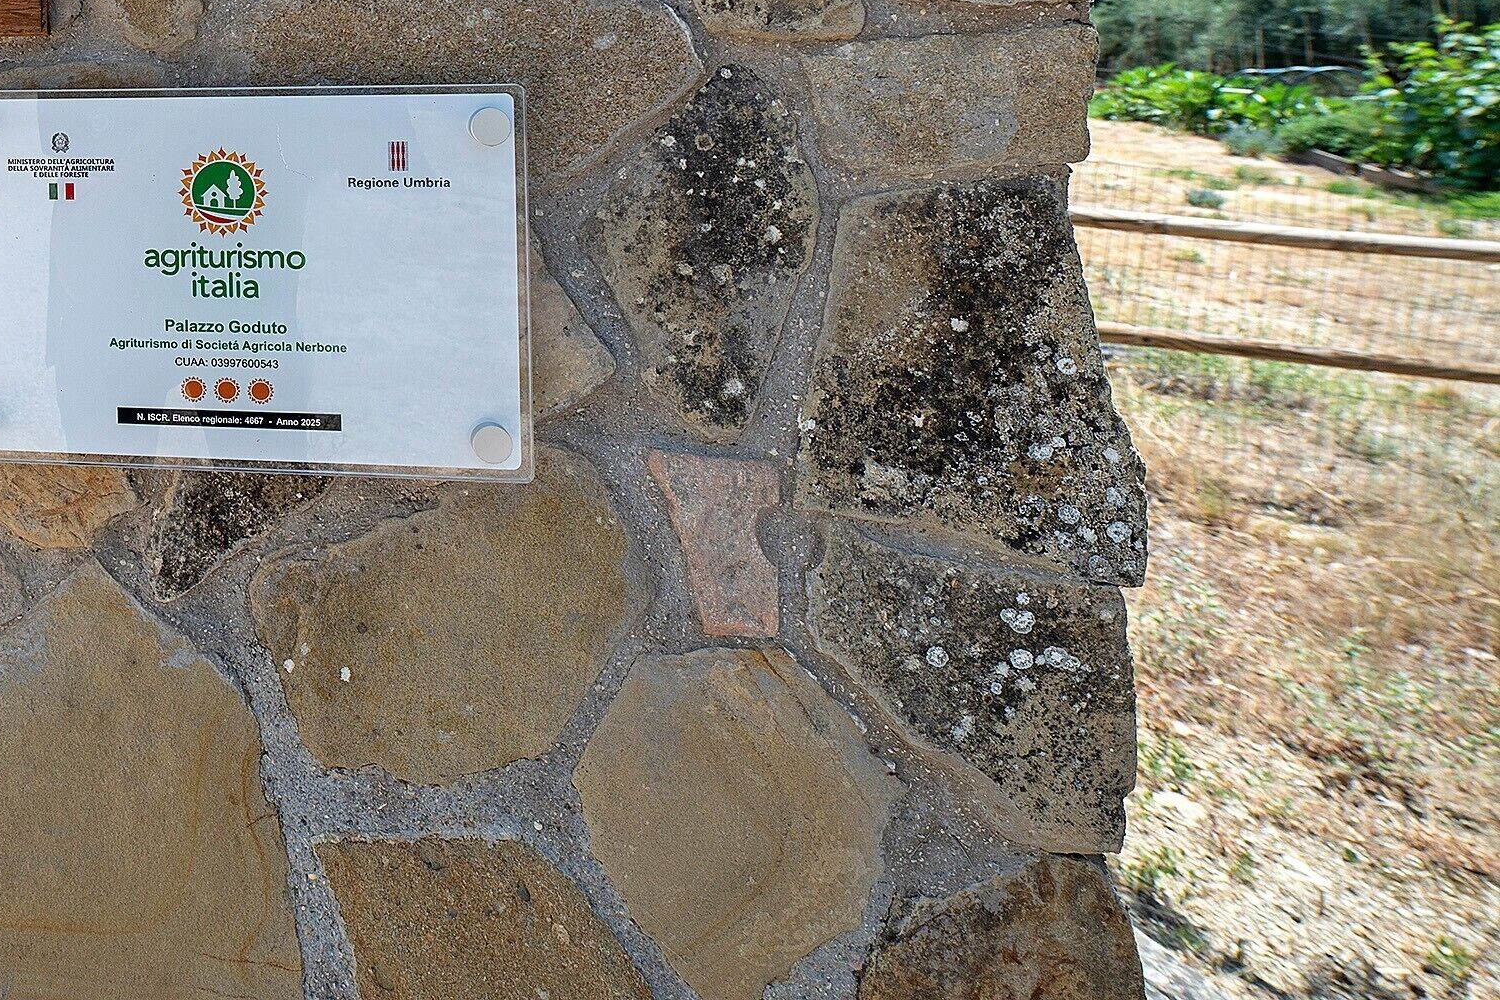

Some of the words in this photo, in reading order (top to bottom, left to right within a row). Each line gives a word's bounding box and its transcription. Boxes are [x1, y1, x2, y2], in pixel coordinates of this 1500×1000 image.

[347, 177, 399, 189] Regione
[404, 177, 451, 188] Umbria
[144, 242, 306, 276] agriturismo
[191, 271, 260, 299] italia
[165, 319, 224, 333] Palazzo
[228, 320, 288, 335] Goduto
[109, 338, 178, 350] Agriturismo
[181, 339, 192, 350] di
[242, 341, 292, 353] Agricola
[295, 342, 347, 353] Nerbone
[174, 357, 208, 367] CUAA:
[211, 358, 279, 369] 03997600543
[136, 412, 145, 421] N.
[148, 413, 170, 422] ISCR.
[172, 414, 200, 423] Elenco
[202, 416, 242, 426] regionale:
[276, 418, 299, 427] Anno
[301, 418, 321, 427] 2025
